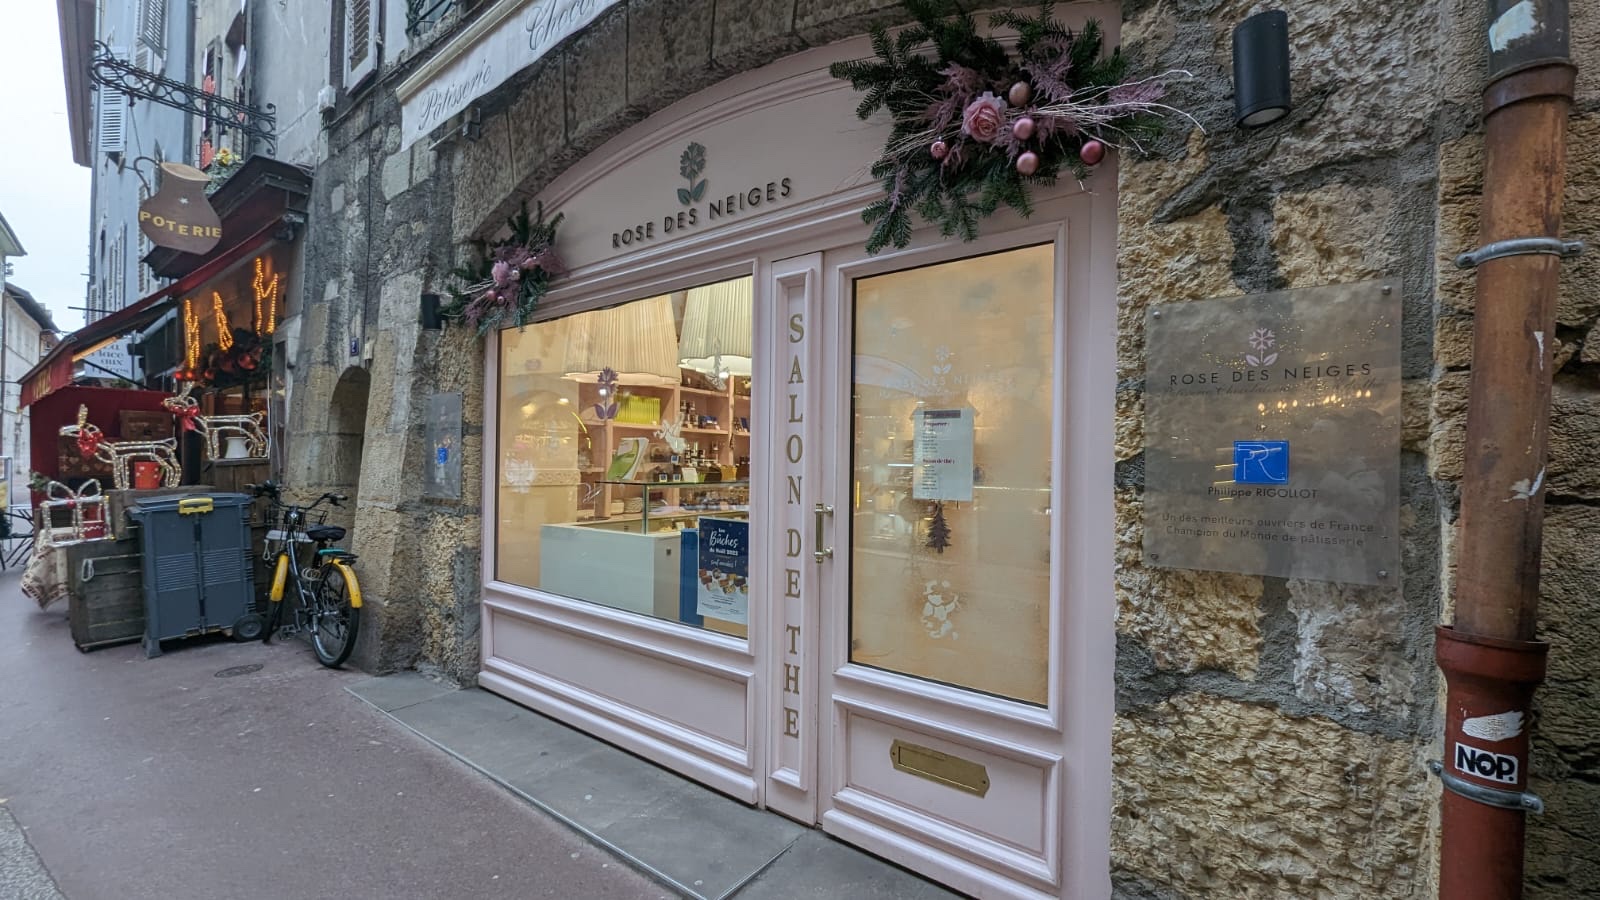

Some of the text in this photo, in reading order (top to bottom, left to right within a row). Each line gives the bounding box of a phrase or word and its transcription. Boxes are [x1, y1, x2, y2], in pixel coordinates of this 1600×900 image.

[612, 177, 792, 248] ROSE DES NEIGES
[139, 210, 222, 238] POTERIE
[1169, 363, 1372, 386] ROSE DES NEIGES
[1208, 486, 1319, 499] Philippe RIGOLLOT
[783, 313, 805, 739] SALON DE THE
[1180, 514, 1198, 523] des
[1201, 515, 1252, 526] meilleurs
[1257, 517, 1306, 529] ouvriers
[1310, 520, 1325, 530] de
[1329, 520, 1374, 533] France
[709, 530, 739, 549] Bûches
[1166, 525, 1364, 547] Champion du Monde de pâtisserie
